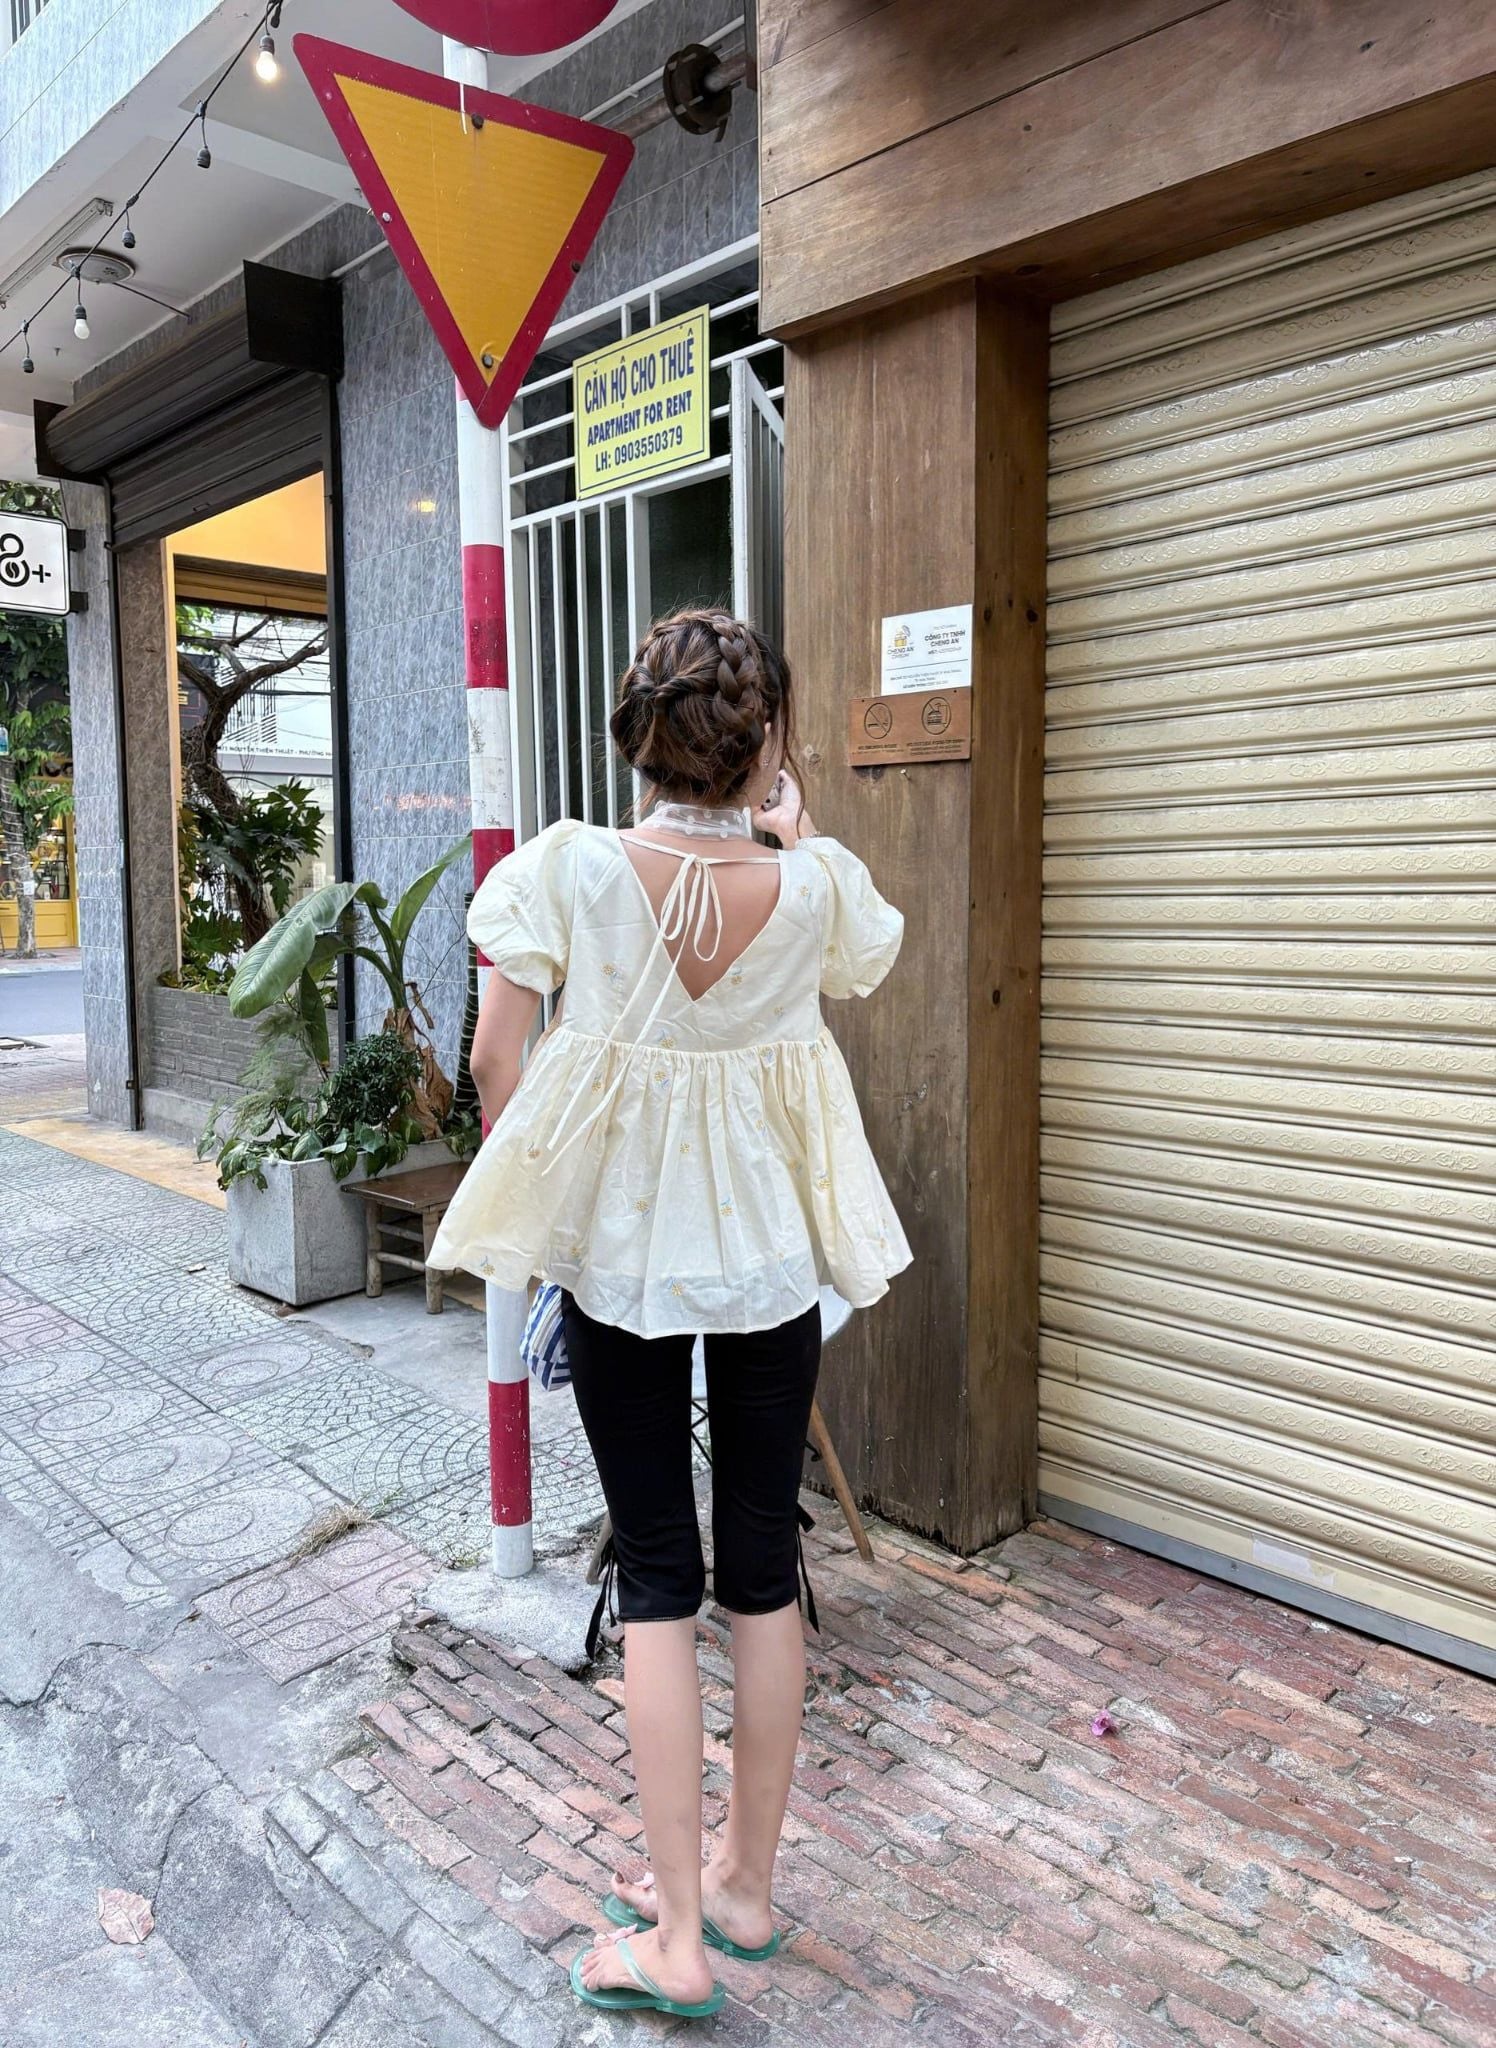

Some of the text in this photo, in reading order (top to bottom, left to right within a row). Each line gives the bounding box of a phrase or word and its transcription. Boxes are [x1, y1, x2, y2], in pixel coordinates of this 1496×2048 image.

[585, 327, 695, 415] CĂN HỘ CHO THUÊ
[587, 390, 693, 447] APARTMENT FOR RENT
[595, 425, 683, 473] LH: 0903550379
[942, 631, 949, 639] TY
